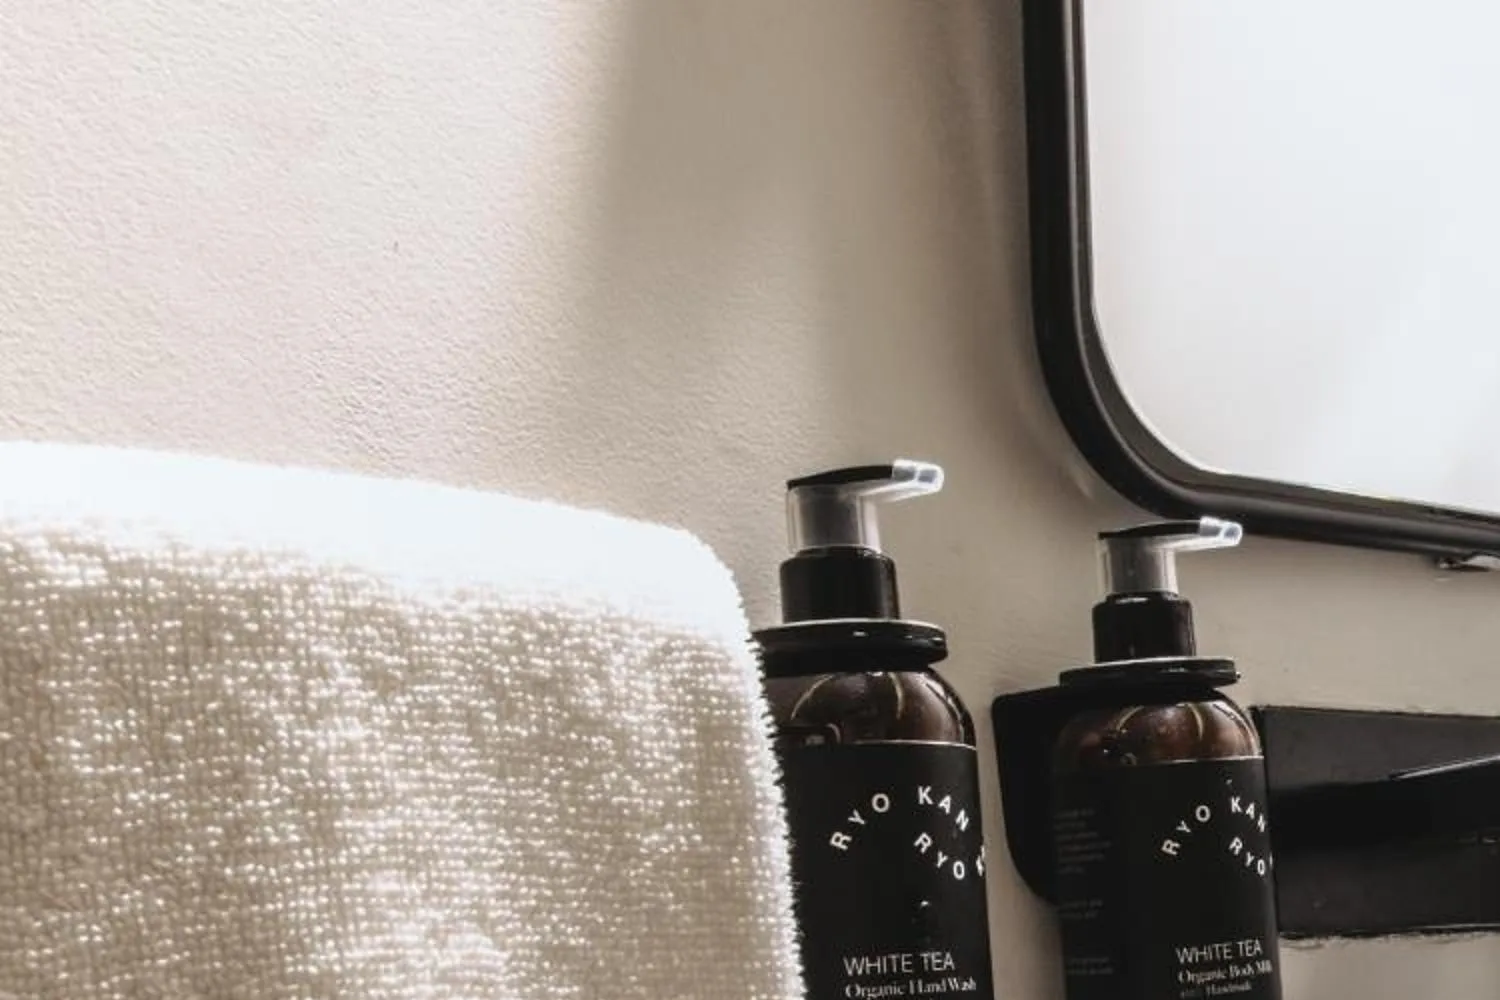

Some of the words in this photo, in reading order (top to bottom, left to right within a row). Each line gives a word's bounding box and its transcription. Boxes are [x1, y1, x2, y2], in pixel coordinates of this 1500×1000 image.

[829, 792, 890, 851] RYO
[917, 785, 970, 833] KAN
[1160, 804, 1211, 857] RYO
[1231, 795, 1268, 833] KAN
[842, 952, 914, 978] WHITE
[919, 950, 956, 972] TEA
[1174, 942, 1233, 965] WHITE
[1235, 938, 1264, 958] TEA
[844, 980, 905, 1000] Organic
